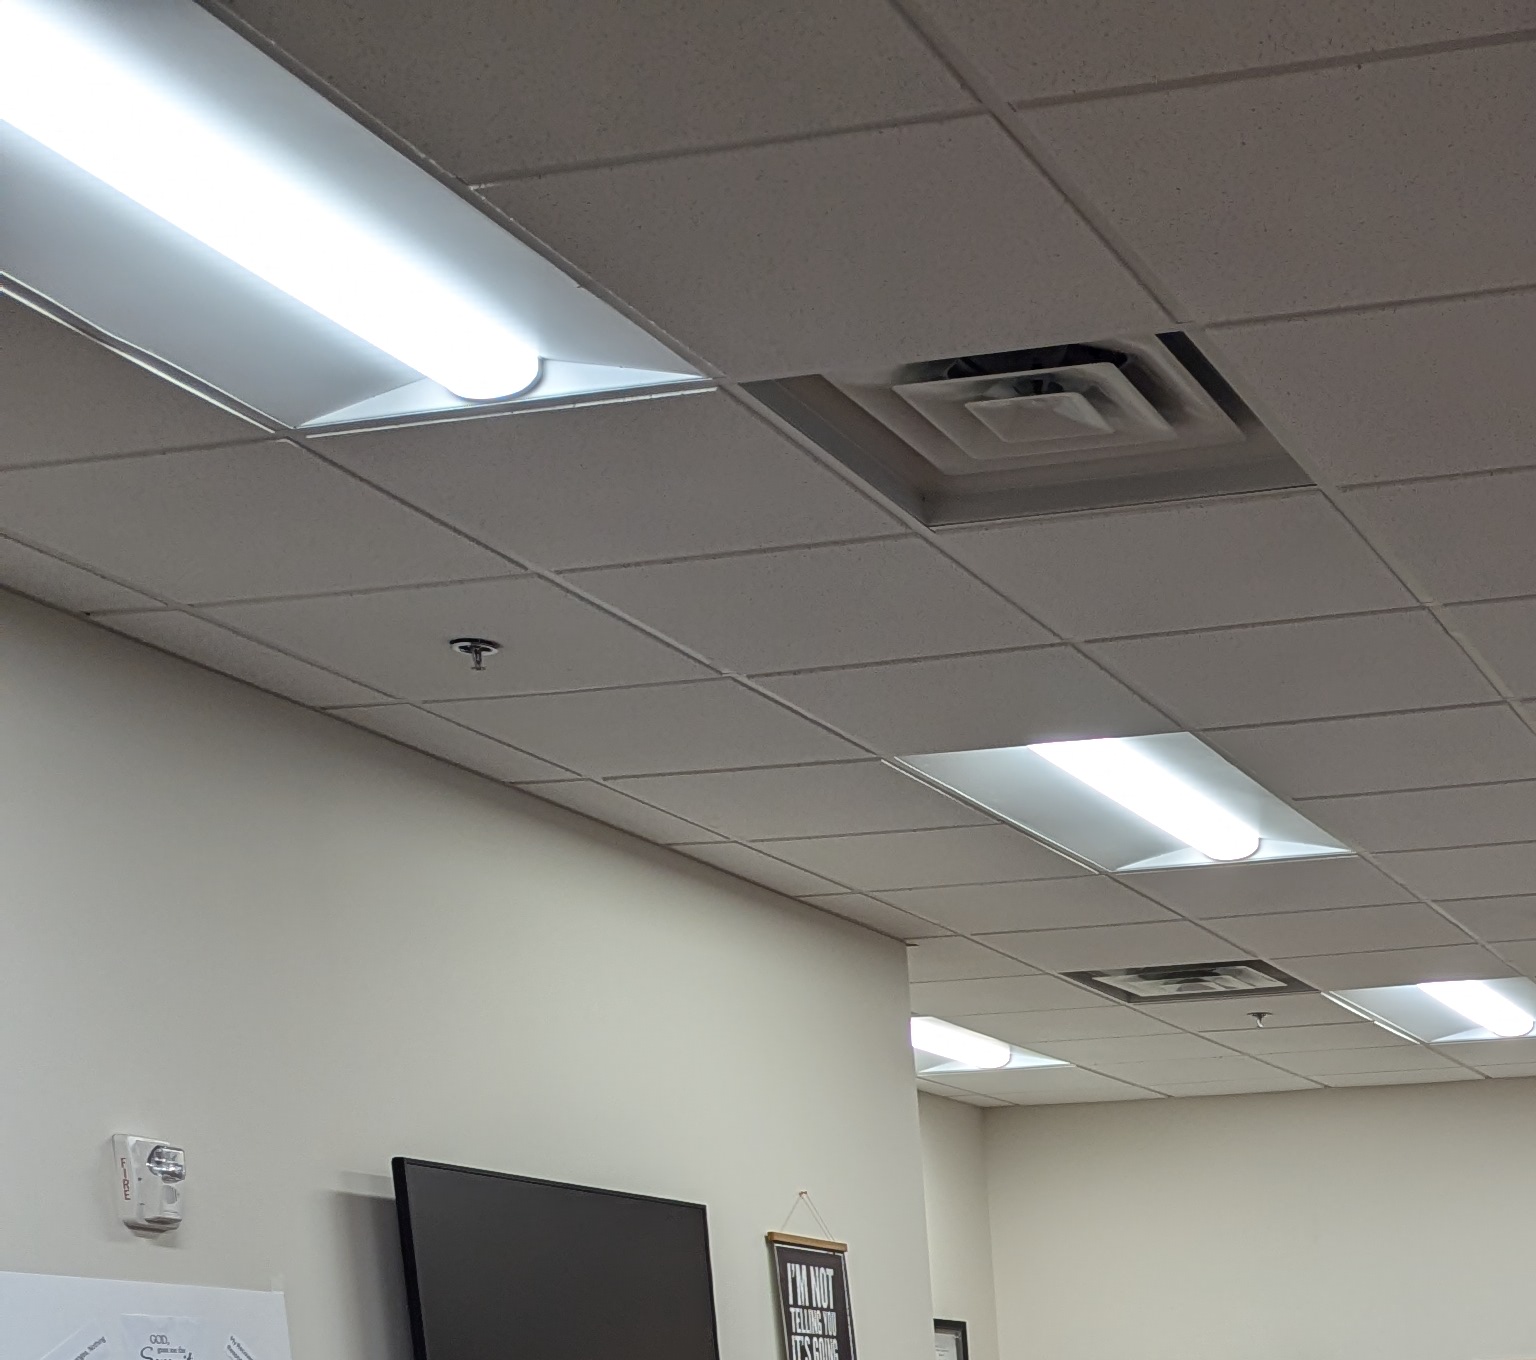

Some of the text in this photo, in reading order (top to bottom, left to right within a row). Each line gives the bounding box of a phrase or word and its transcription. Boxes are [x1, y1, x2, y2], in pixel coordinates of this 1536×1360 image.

[120, 1157, 131, 1201] FIRE
[787, 1262, 834, 1309] I'M NOT
[789, 1307, 837, 1337] TELLING YOU
